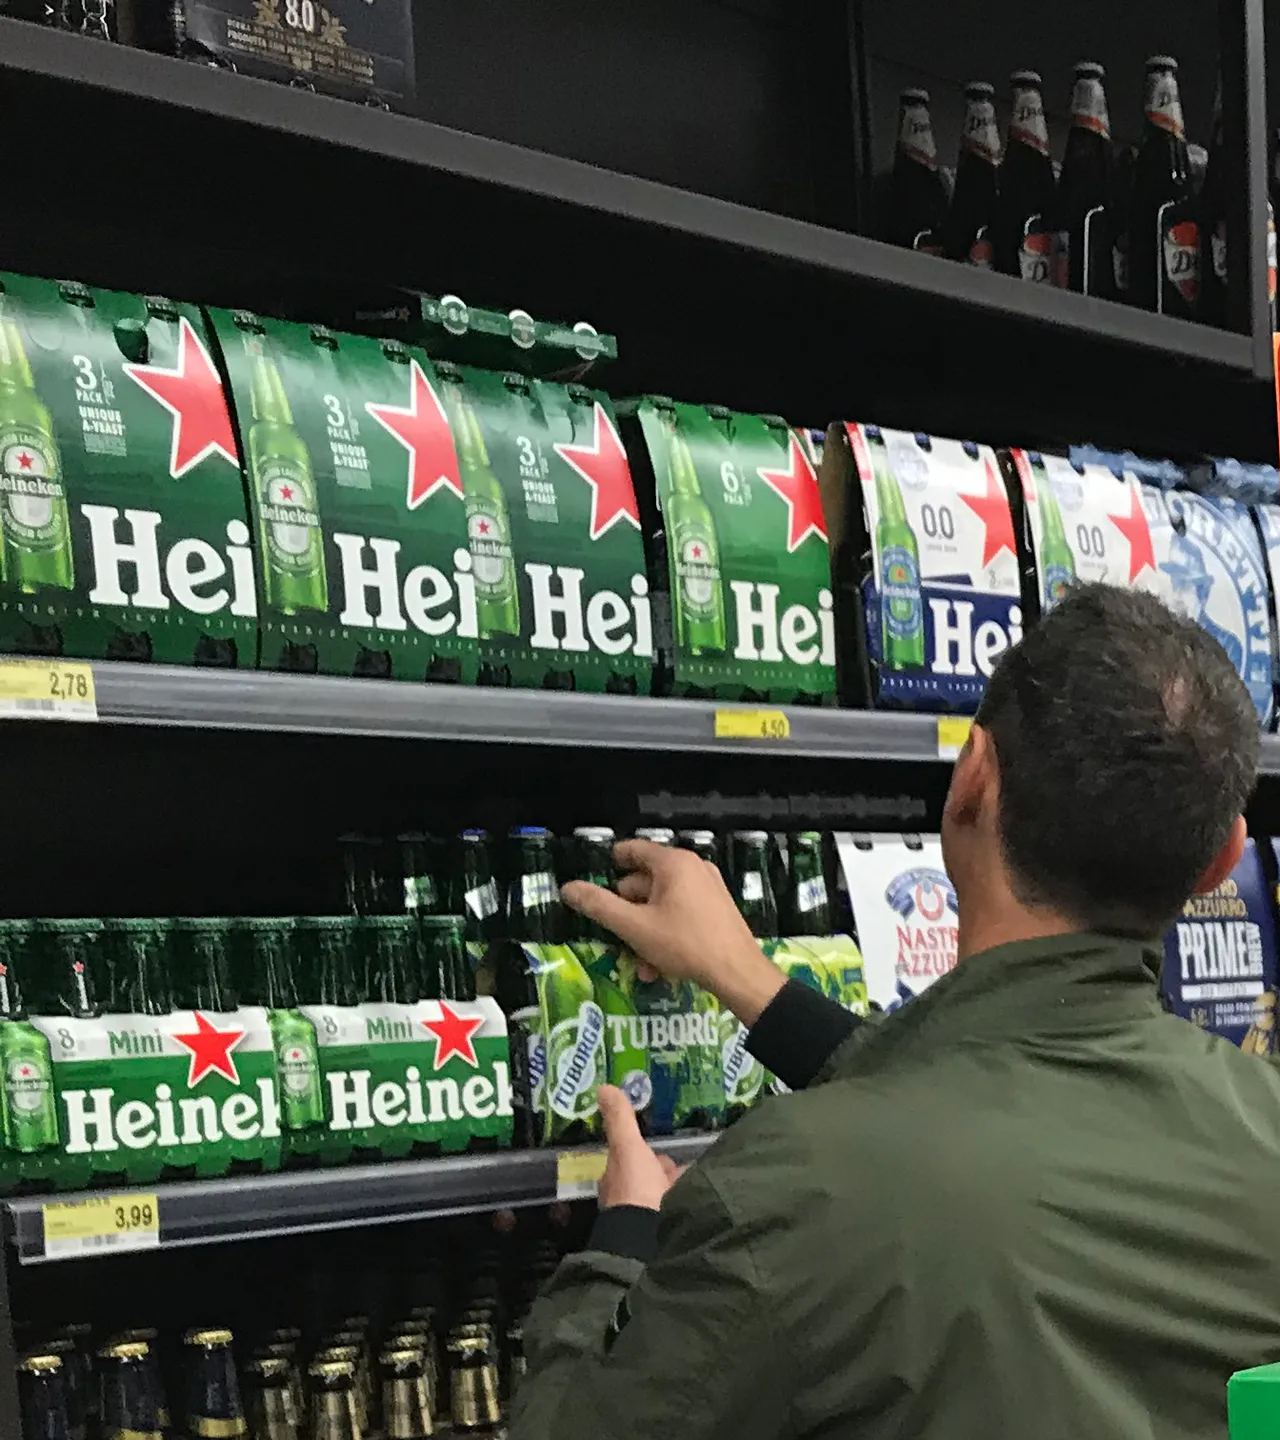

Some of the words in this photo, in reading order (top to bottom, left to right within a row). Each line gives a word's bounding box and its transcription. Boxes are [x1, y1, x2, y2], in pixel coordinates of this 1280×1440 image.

[73, 355, 97, 390] 3
[323, 394, 345, 427] 3
[516, 436, 535, 466] 3
[721, 461, 738, 492] 6
[81, 504, 257, 618] Hei
[333, 532, 478, 638] Hei
[525, 563, 652, 656] Hei
[730, 580, 835, 666] Hei
[50, 672, 88, 699] 2,78
[896, 925, 958, 954] NASTR
[1177, 922, 1248, 979] PRIME
[108, 1030, 163, 1055] Mini
[367, 1017, 412, 1041] Mini
[606, 1010, 718, 1053] TUBORG
[115, 1205, 153, 1232] 3,99
